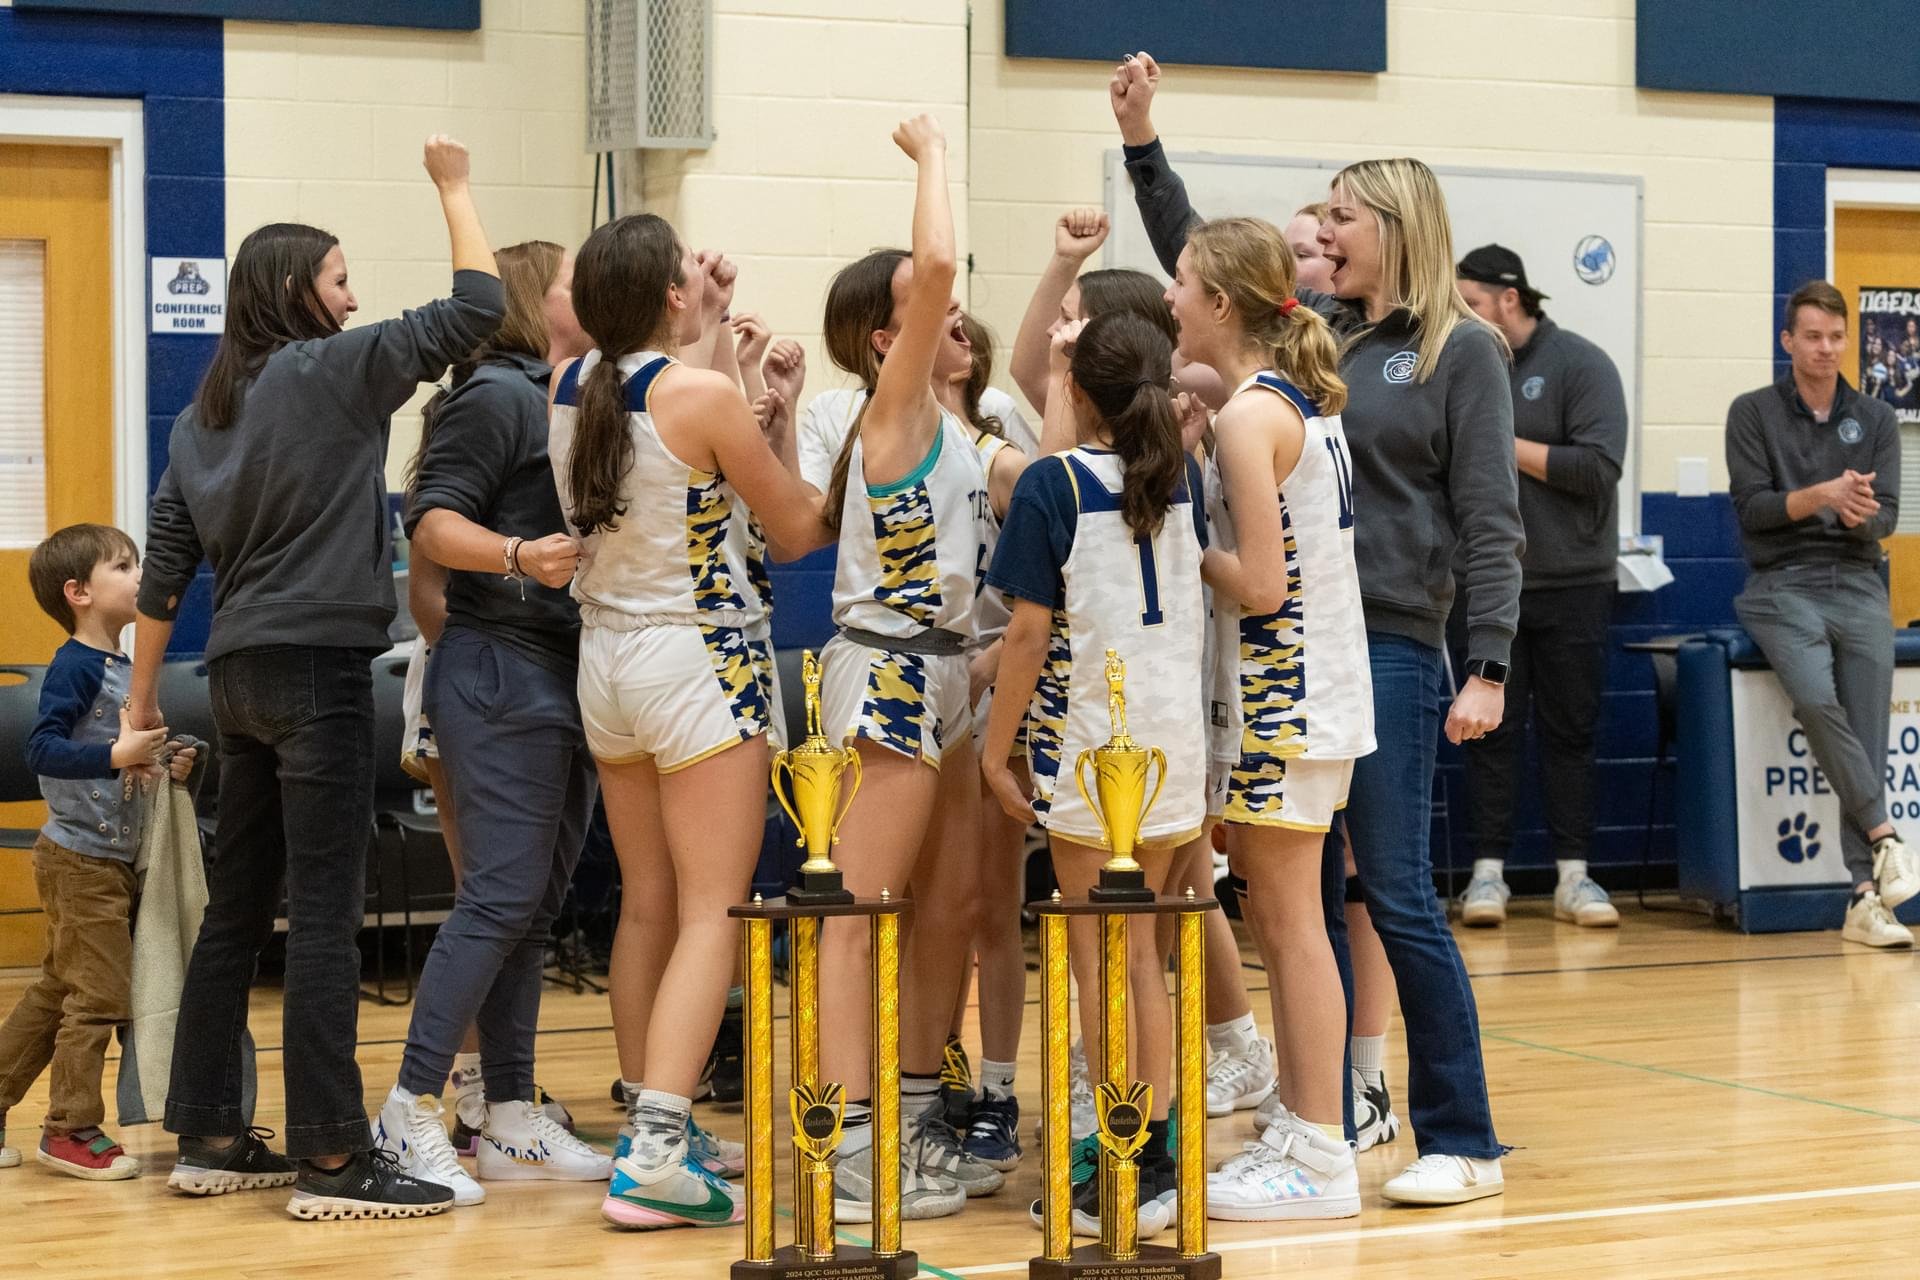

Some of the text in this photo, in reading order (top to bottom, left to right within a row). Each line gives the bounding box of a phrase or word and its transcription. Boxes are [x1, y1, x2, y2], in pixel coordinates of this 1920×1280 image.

[175, 283, 203, 293] PREP
[155, 303, 223, 315] CONFERENCE
[172, 317, 206, 329] ROOM
[1132, 530, 1164, 626] 1
[823, 1268, 841, 1276] Girls
[841, 1266, 877, 1275] Basketball
[1140, 1266, 1176, 1274] Basketball
